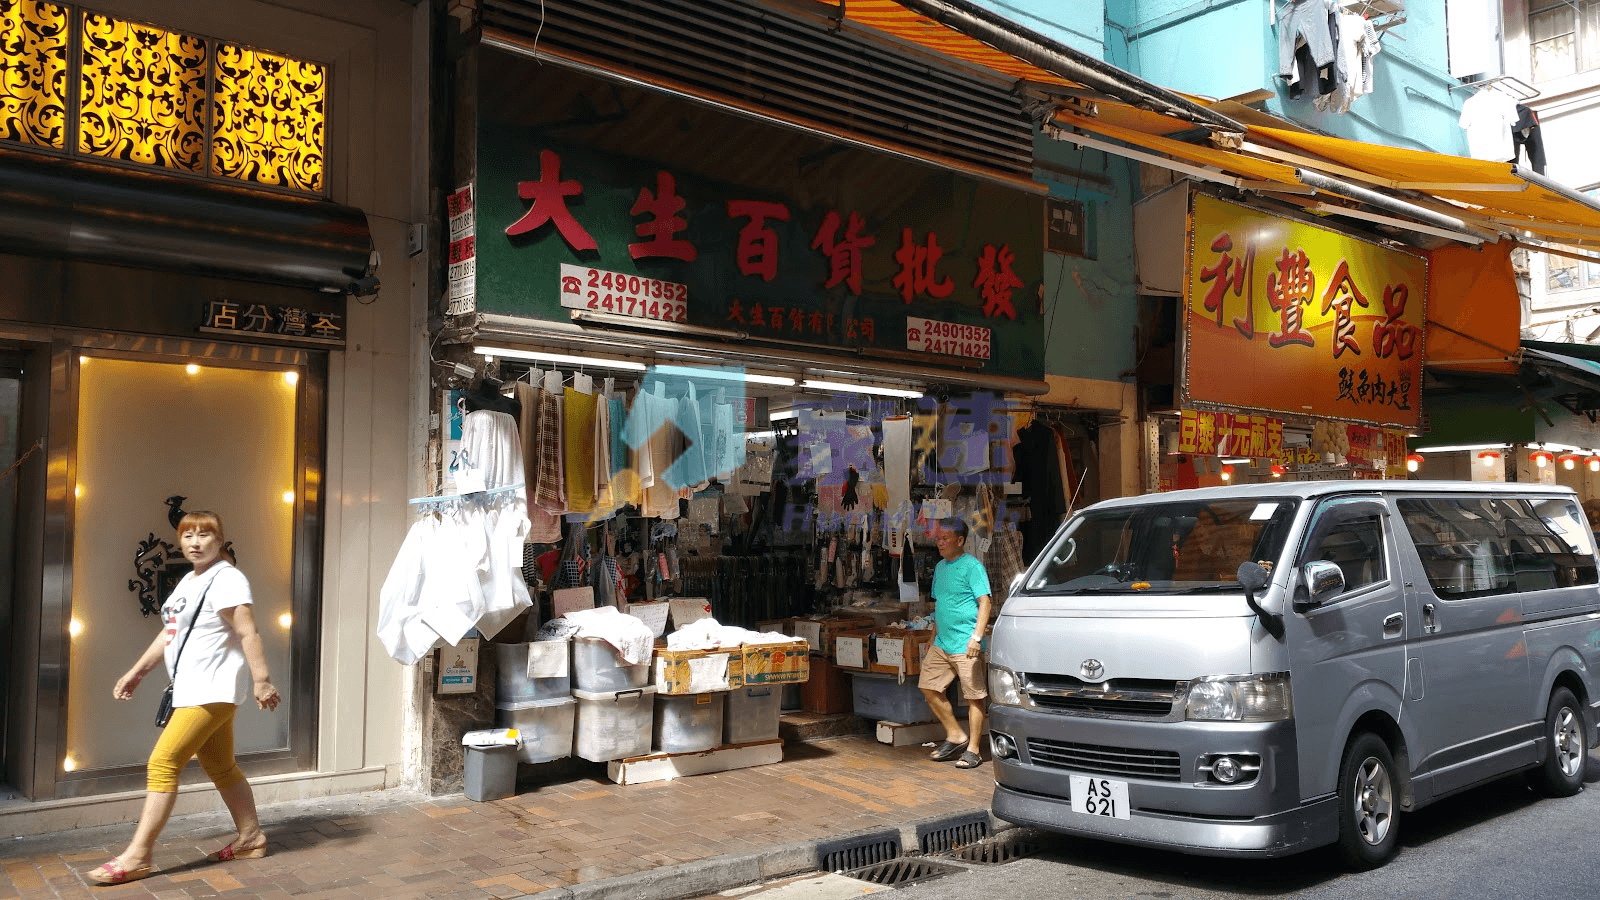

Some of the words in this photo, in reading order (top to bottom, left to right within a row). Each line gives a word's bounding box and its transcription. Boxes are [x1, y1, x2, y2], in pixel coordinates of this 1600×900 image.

[505, 150, 1024, 320] 大生百貨批發
[587, 269, 687, 302] 24901352
[1200, 232, 1416, 360] 利豐食品
[587, 290, 687, 321] 24171422
[924, 320, 990, 342] 24901352
[924, 338, 990, 358] 24171422
[1088, 778, 1111, 798] AS
[1086, 796, 1115, 817] 621
